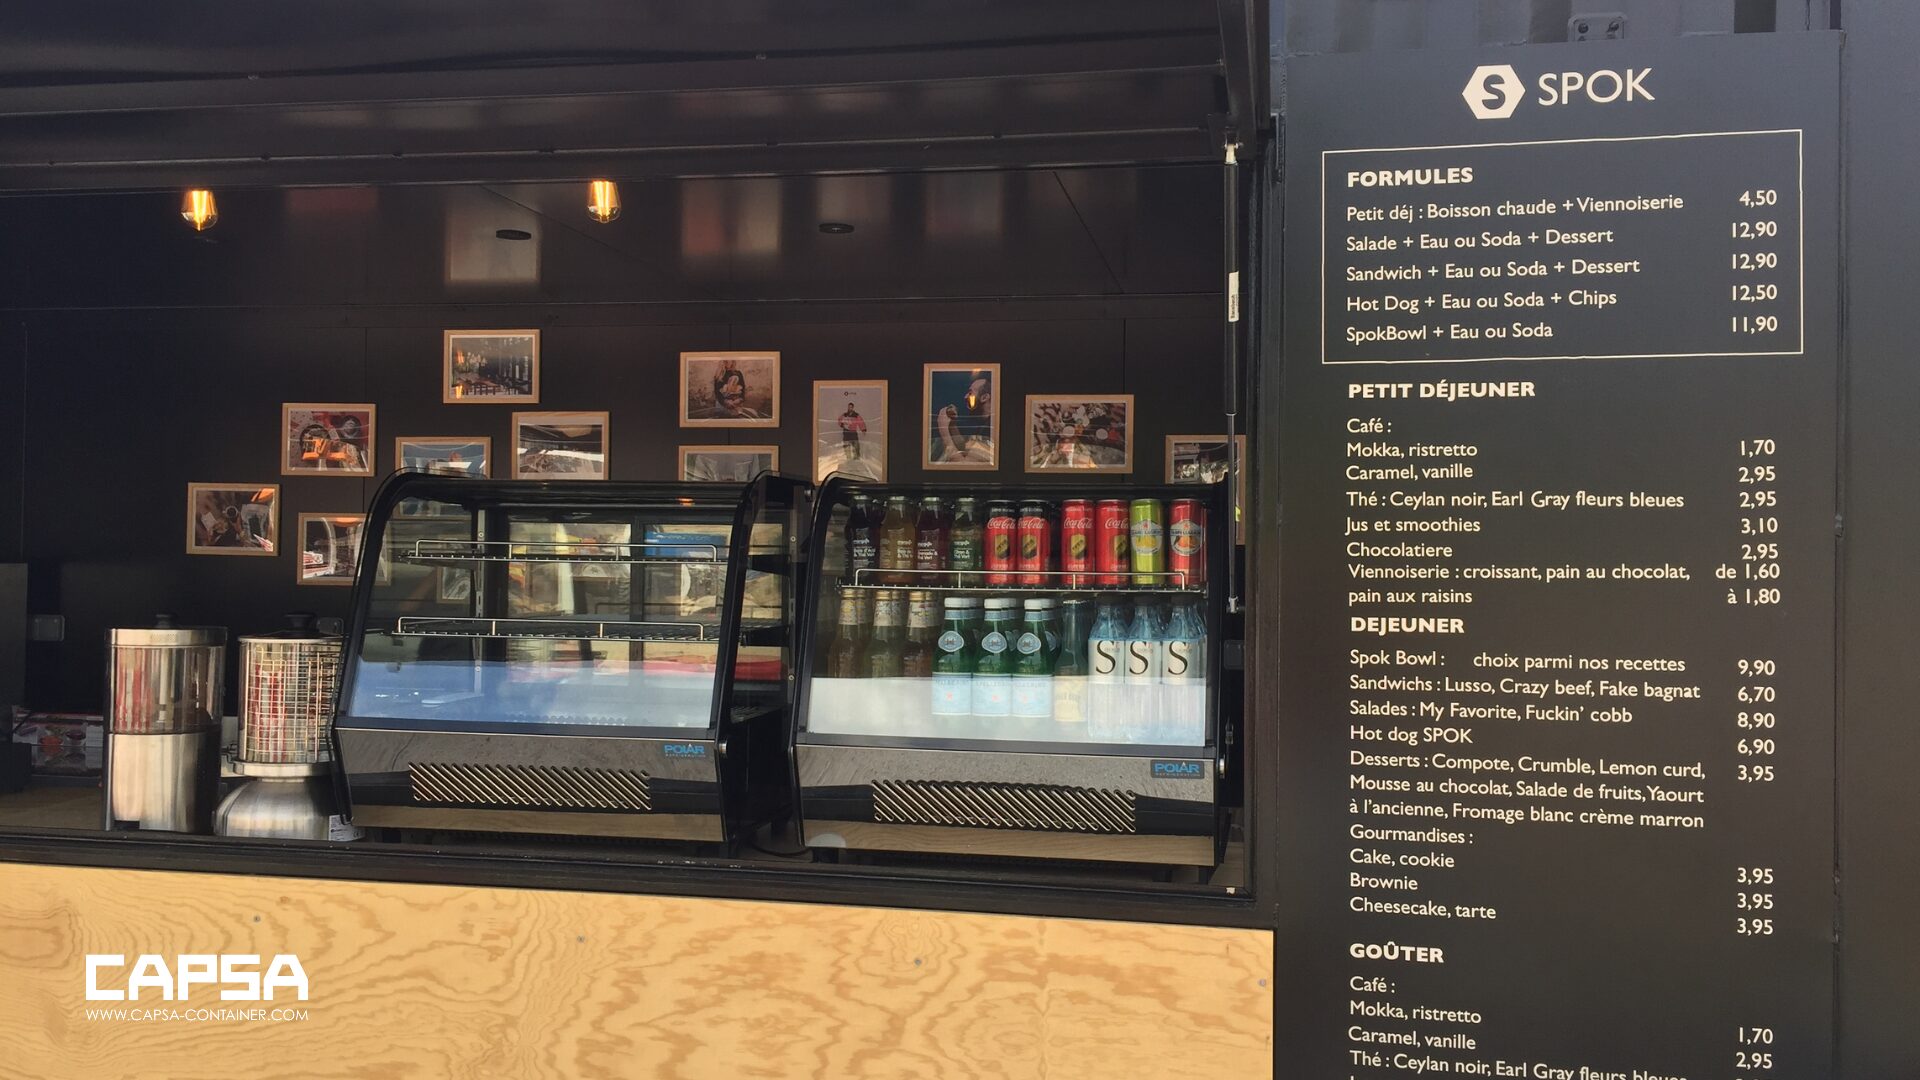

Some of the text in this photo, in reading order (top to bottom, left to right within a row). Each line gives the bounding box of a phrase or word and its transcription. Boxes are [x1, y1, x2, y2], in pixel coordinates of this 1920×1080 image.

[1538, 67, 1656, 107] SPOK
[1347, 166, 1474, 188] FORMULES
[1346, 205, 1385, 222] Petit
[1427, 203, 1492, 219] Boisson
[1496, 198, 1557, 217] chaude
[1561, 200, 1575, 212] +
[1576, 193, 1684, 213] Viennoiserie
[1738, 188, 1778, 209] 4,50
[1346, 228, 1615, 252] Salade + Eau ou Soda + Dessert
[1731, 220, 1778, 240] 12,90
[1346, 258, 1641, 282] Sandwich + Eau ou Soda + Dessert
[1731, 252, 1778, 272] 12,90
[1346, 289, 1618, 315] Hot Dog + Eau ou Soda + Chips
[1732, 283, 1778, 303] 12,50
[1345, 321, 1554, 347] SpokBowl + Eau ou Soda
[1732, 315, 1779, 335] 11,90
[1348, 378, 1536, 403] PETIT DÉJEUNER
[1346, 441, 1479, 460] Mokka, ristretto
[1740, 438, 1776, 459] 1,70
[1345, 462, 1474, 482] Caramel, vanille
[1738, 465, 1777, 485] 2,95
[1389, 490, 1446, 511] Ceylan
[1450, 491, 1488, 509] noir,
[1491, 490, 1524, 507] Earl
[1530, 489, 1571, 511] Gray
[1574, 489, 1624, 508] fleurs
[1629, 491, 1685, 508] bleues
[1738, 490, 1777, 510] 2,95
[1343, 516, 1482, 537] Jus et smoothies
[1740, 516, 1779, 537] 3,10
[1346, 541, 1453, 558] Chocolatiere
[1740, 542, 1779, 562] 2,95
[1462, 563, 1543, 581] croissant,
[1545, 563, 1581, 584] pain
[1585, 567, 1606, 580] au
[1611, 562, 1691, 582] chocolat,
[1714, 562, 1781, 581] de 1,60
[1348, 587, 1473, 608] pain aux raisins
[1726, 587, 1781, 607] à 1,80
[1350, 616, 1465, 637] DEJEUNER
[1096, 639, 1116, 675] S
[1129, 640, 1149, 676] S
[1168, 639, 1188, 676] S
[1349, 648, 1391, 670] Spok
[1472, 651, 1520, 669] choix
[1524, 654, 1573, 673] parmi
[1578, 657, 1610, 671] nos
[1615, 658, 1686, 672] recettes
[1737, 658, 1776, 678] 9,90
[1444, 676, 1496, 696] Lusso,
[1499, 677, 1550, 699] Crazy
[1554, 678, 1596, 698] beef,
[1599, 679, 1639, 698] Fake
[1643, 681, 1702, 703] bagnat
[1737, 685, 1776, 705] 6,70
[1419, 700, 1445, 723] My
[1449, 701, 1522, 722] Favorite,
[1589, 706, 1633, 724] cobb
[1736, 711, 1776, 731] 8,90
[1349, 724, 1474, 747] Hot dog SPOK
[664, 743, 705, 754] POLAR
[1736, 737, 1776, 757] 6,90
[1154, 761, 1200, 774] POLAR
[1431, 752, 1515, 775] Compote,
[1517, 755, 1596, 777] Crumble,
[1599, 758, 1658, 777] Lemon
[1662, 761, 1706, 781] curd,
[1737, 764, 1775, 784] 3,95
[1349, 773, 1411, 792] Mousse
[1415, 780, 1435, 793] au
[1438, 777, 1513, 798] chocolat,
[1515, 779, 1568, 798] Salade
[1572, 782, 1594, 799] de
[1348, 797, 1360, 814] à
[1452, 802, 1525, 825] Fromage
[1529, 805, 1574, 823] blanc
[1578, 807, 1635, 826] crème
[1639, 814, 1705, 829] marron
[1349, 847, 1455, 869] Cake, cookie
[1349, 871, 1419, 891] Brownie
[1736, 866, 1774, 886] 3,95
[1349, 895, 1497, 920] Cheesecake, tarte
[1736, 891, 1774, 912] 3,95
[1736, 917, 1774, 937] 3,95
[1349, 940, 1445, 964] GOÛTER
[1349, 999, 1483, 1024] Mokka, ristretto
[1347, 1025, 1477, 1051] Caramel, vanille
[1738, 1026, 1774, 1046] 1,70
[1393, 1052, 1450, 1075] Ceylan
[1454, 1059, 1492, 1078] noir,
[1495, 1059, 1528, 1078] Earl
[1532, 1062, 1575, 1080] Gray
[1735, 1051, 1773, 1071] 2,95
